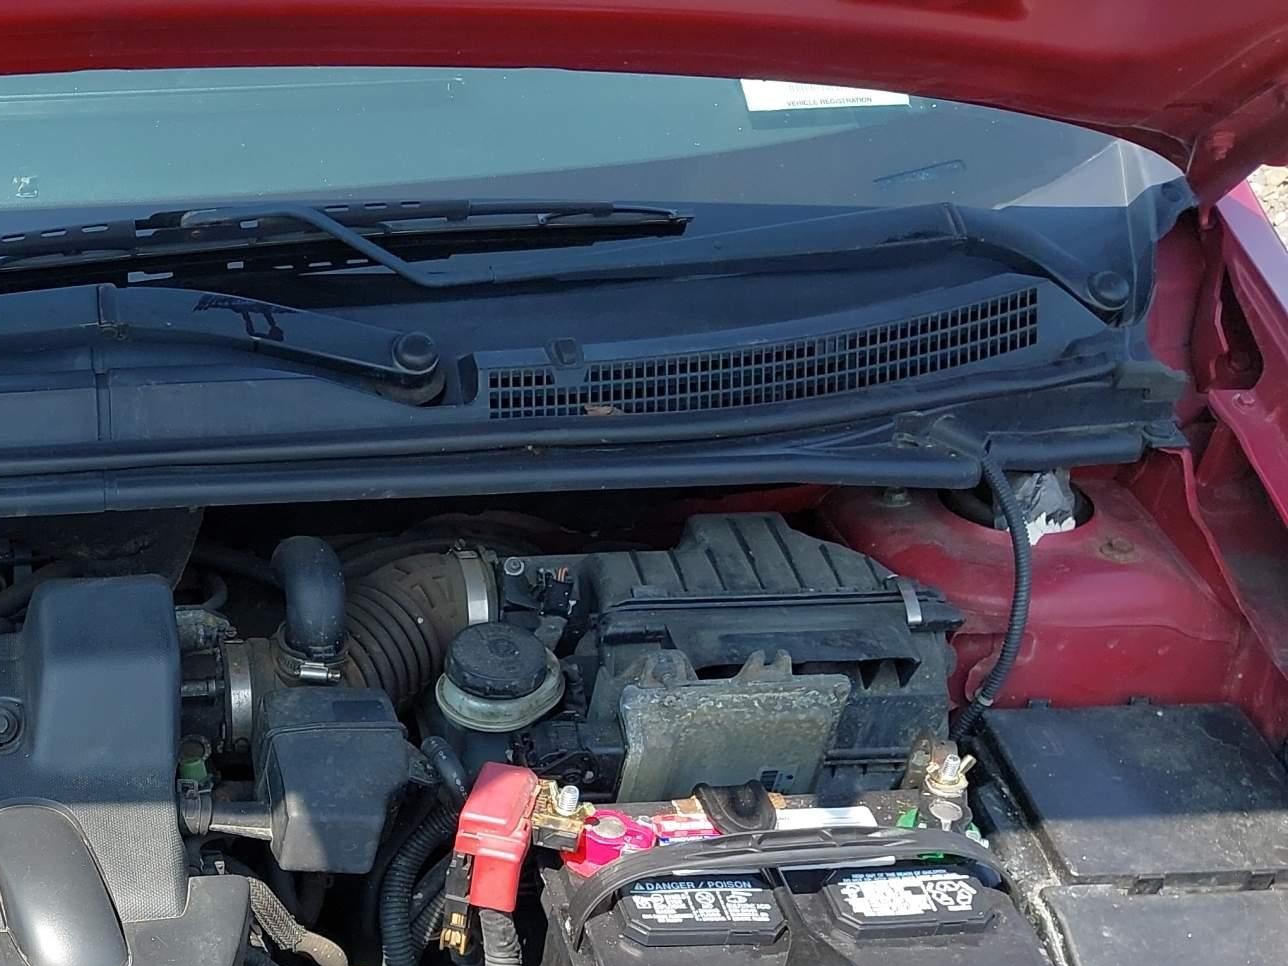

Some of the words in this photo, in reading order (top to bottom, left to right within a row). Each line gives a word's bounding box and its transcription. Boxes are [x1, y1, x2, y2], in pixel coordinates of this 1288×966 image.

[819, 97, 872, 105] REGISTRATION
[645, 881, 695, 890] DANGER
[707, 880, 752, 889] POISON
